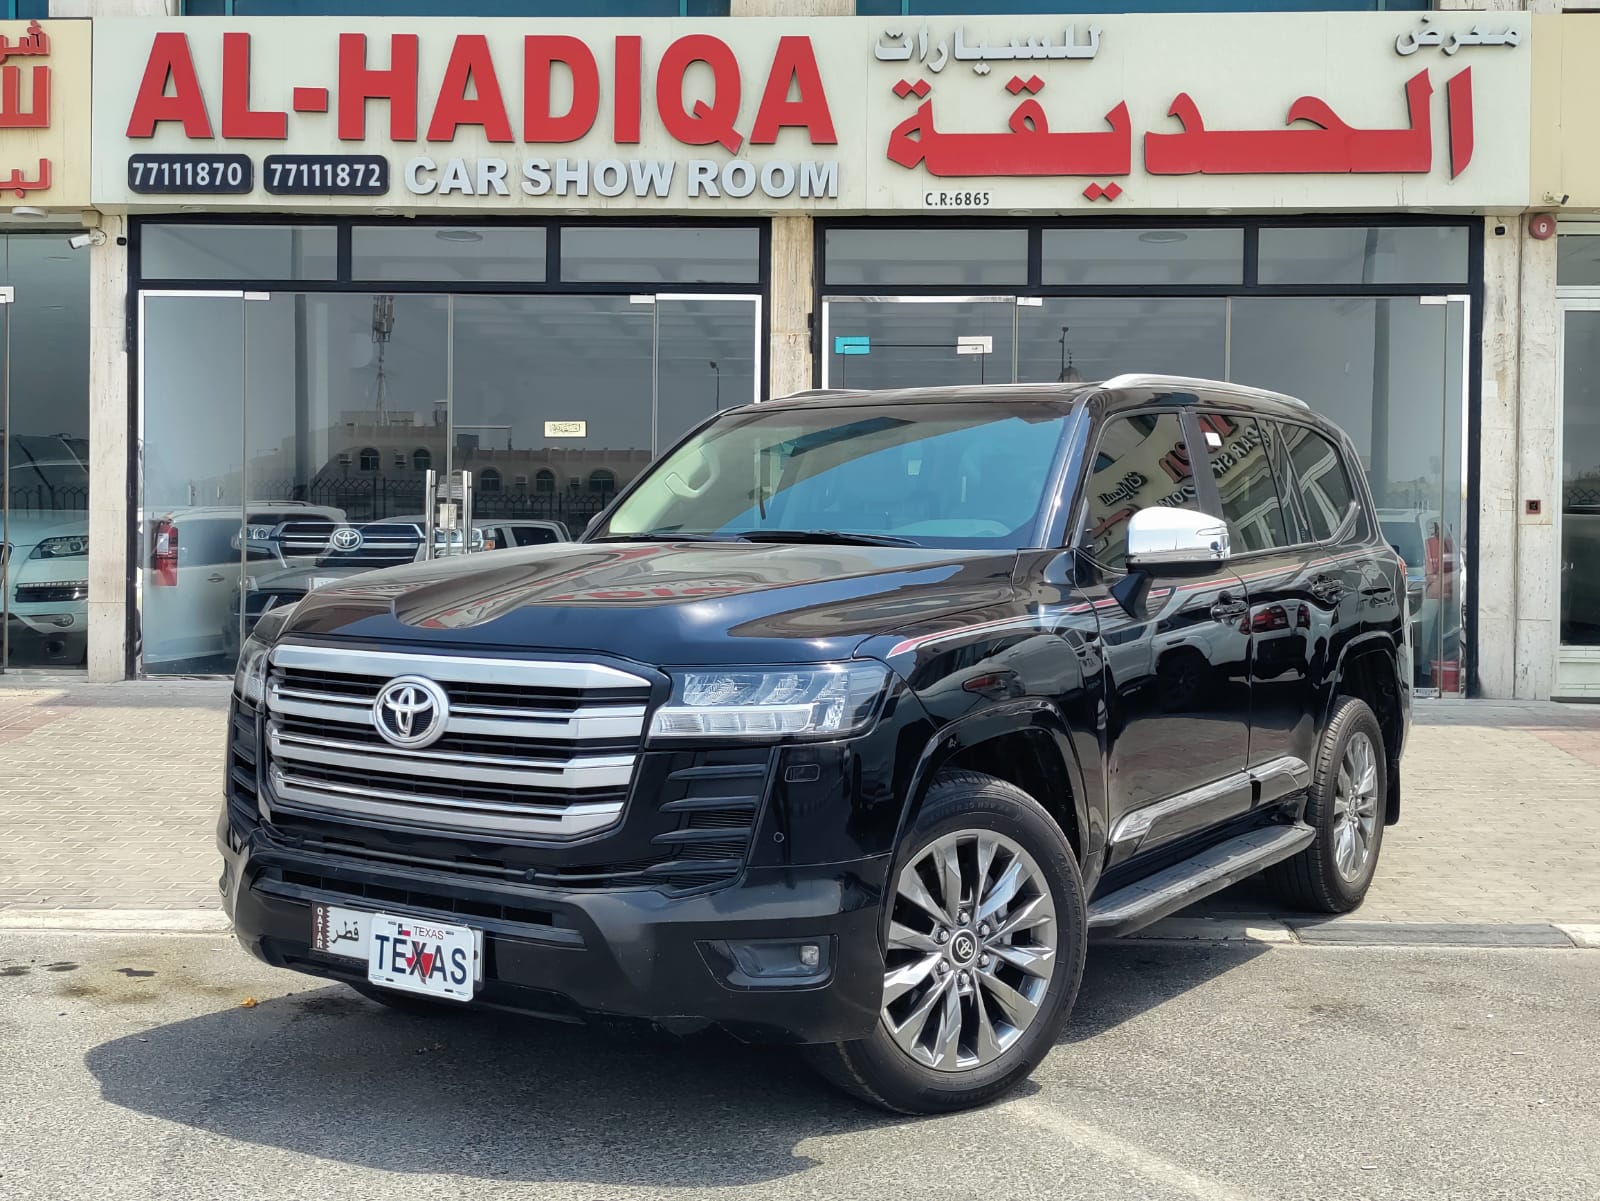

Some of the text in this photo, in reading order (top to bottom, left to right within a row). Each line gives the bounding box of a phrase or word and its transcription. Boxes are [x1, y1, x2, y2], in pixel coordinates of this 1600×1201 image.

[874, 22, 1103, 74] للسيارات
[1395, 14, 1521, 56] معرض
[126, 32, 838, 155] AL-HADIQA
[887, 67, 1475, 201] الحديقة
[132, 162, 242, 187] 77111870
[270, 164, 381, 188] 77111872
[404, 156, 840, 199] CAR SHOW ROOM
[925, 191, 990, 206] C.R:6865
[315, 906, 324, 949] QATAR
[331, 920, 360, 944] قطر
[413, 925, 445, 941] TEXAS
[375, 933, 467, 986] TEXAS
